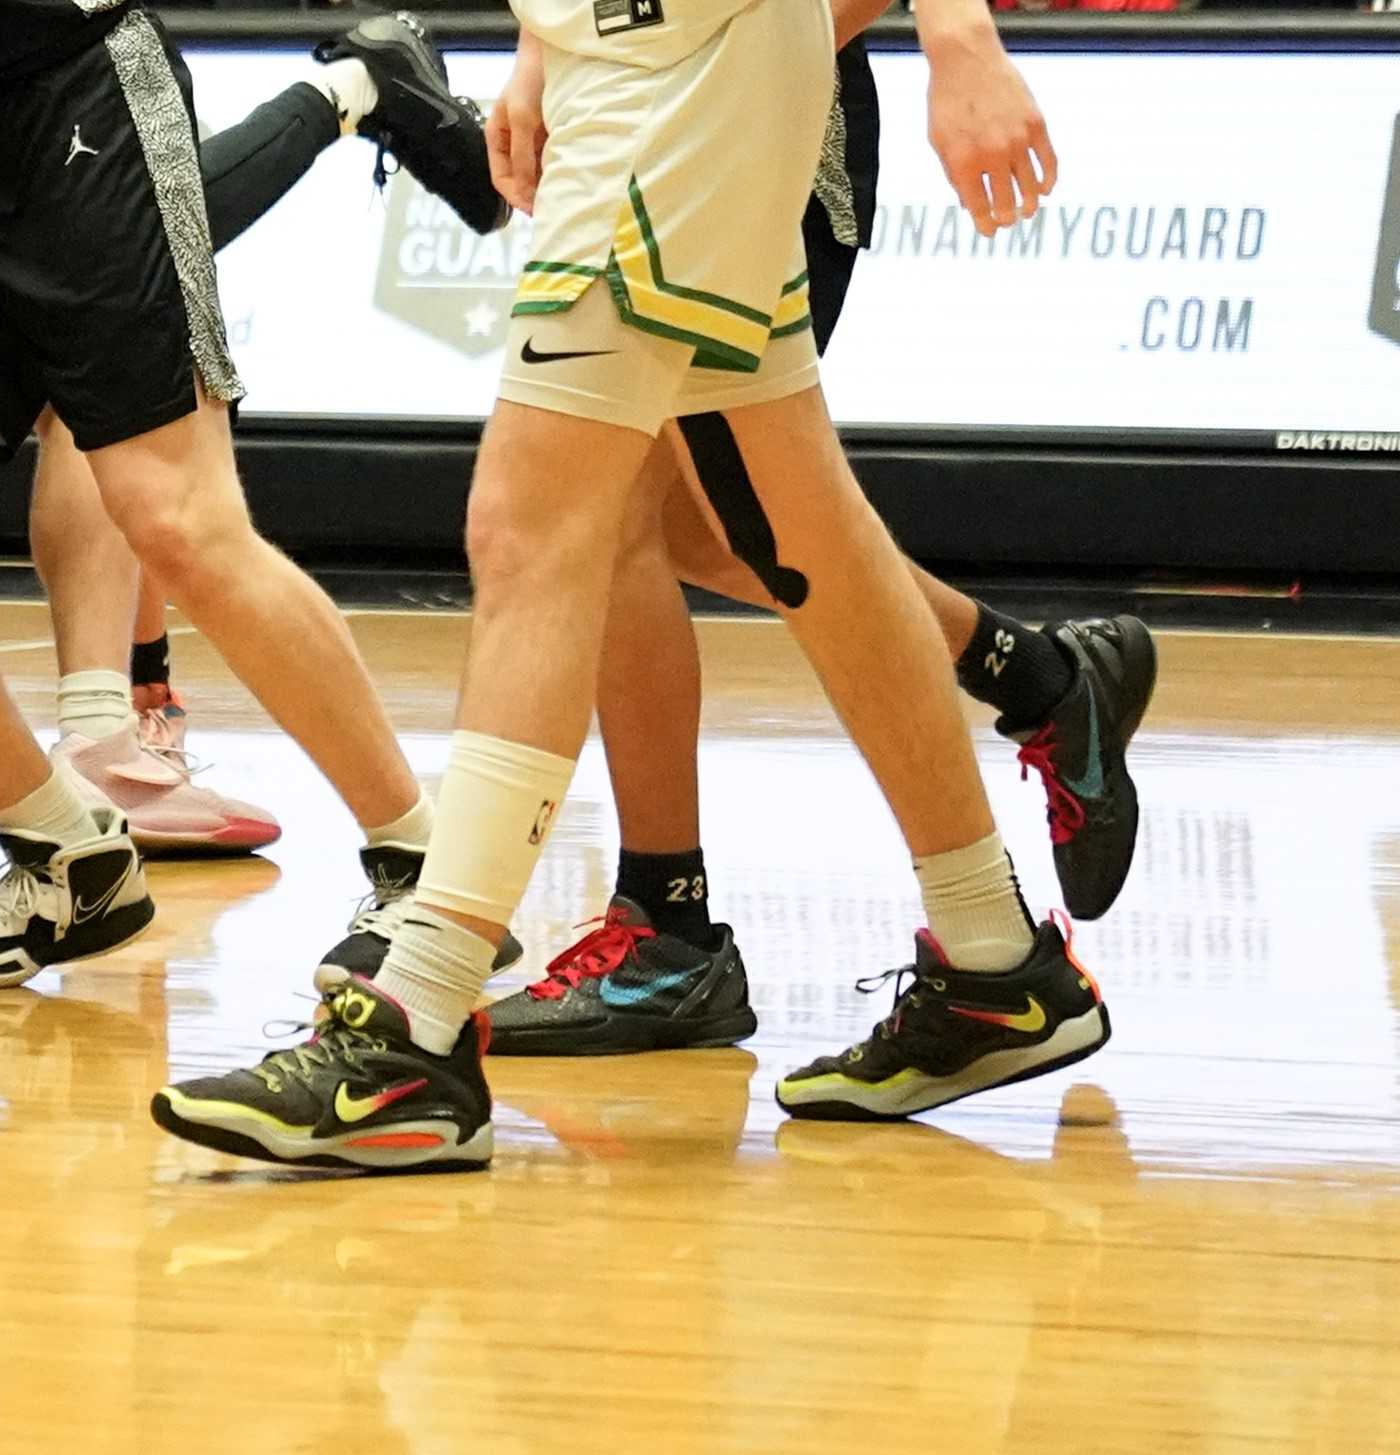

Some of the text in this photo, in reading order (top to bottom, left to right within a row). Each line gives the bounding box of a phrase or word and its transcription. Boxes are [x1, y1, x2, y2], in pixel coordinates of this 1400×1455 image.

[637, 0, 653, 17] M
[1120, 295, 1255, 353] .COM
[1276, 431, 1400, 451] DAKTRONI
[983, 628, 1016, 679] 23
[665, 875, 704, 902] 23
